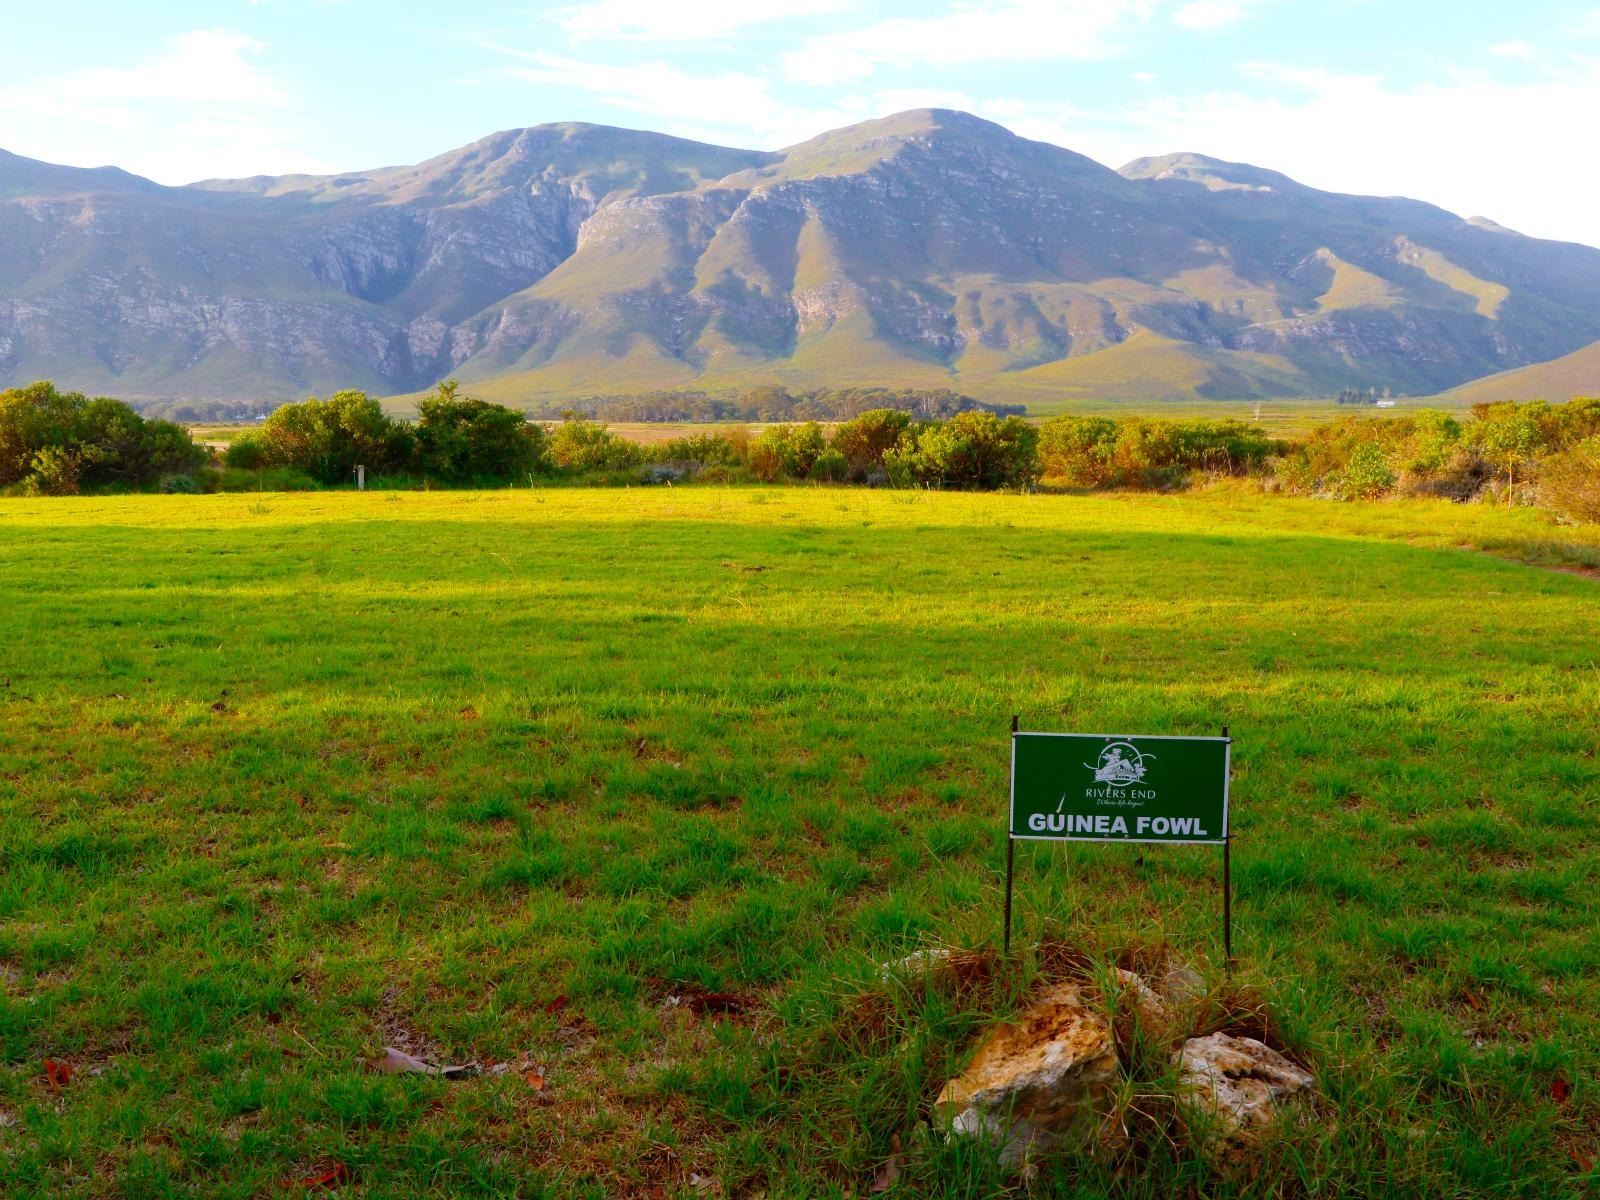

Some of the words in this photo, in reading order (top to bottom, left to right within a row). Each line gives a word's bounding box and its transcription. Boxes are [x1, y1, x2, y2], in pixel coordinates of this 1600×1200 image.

[1086, 788, 1126, 799] RIVERS
[1131, 789, 1156, 800] END
[1028, 813, 1128, 833] GUINEA
[1136, 816, 1208, 836] FOWL
